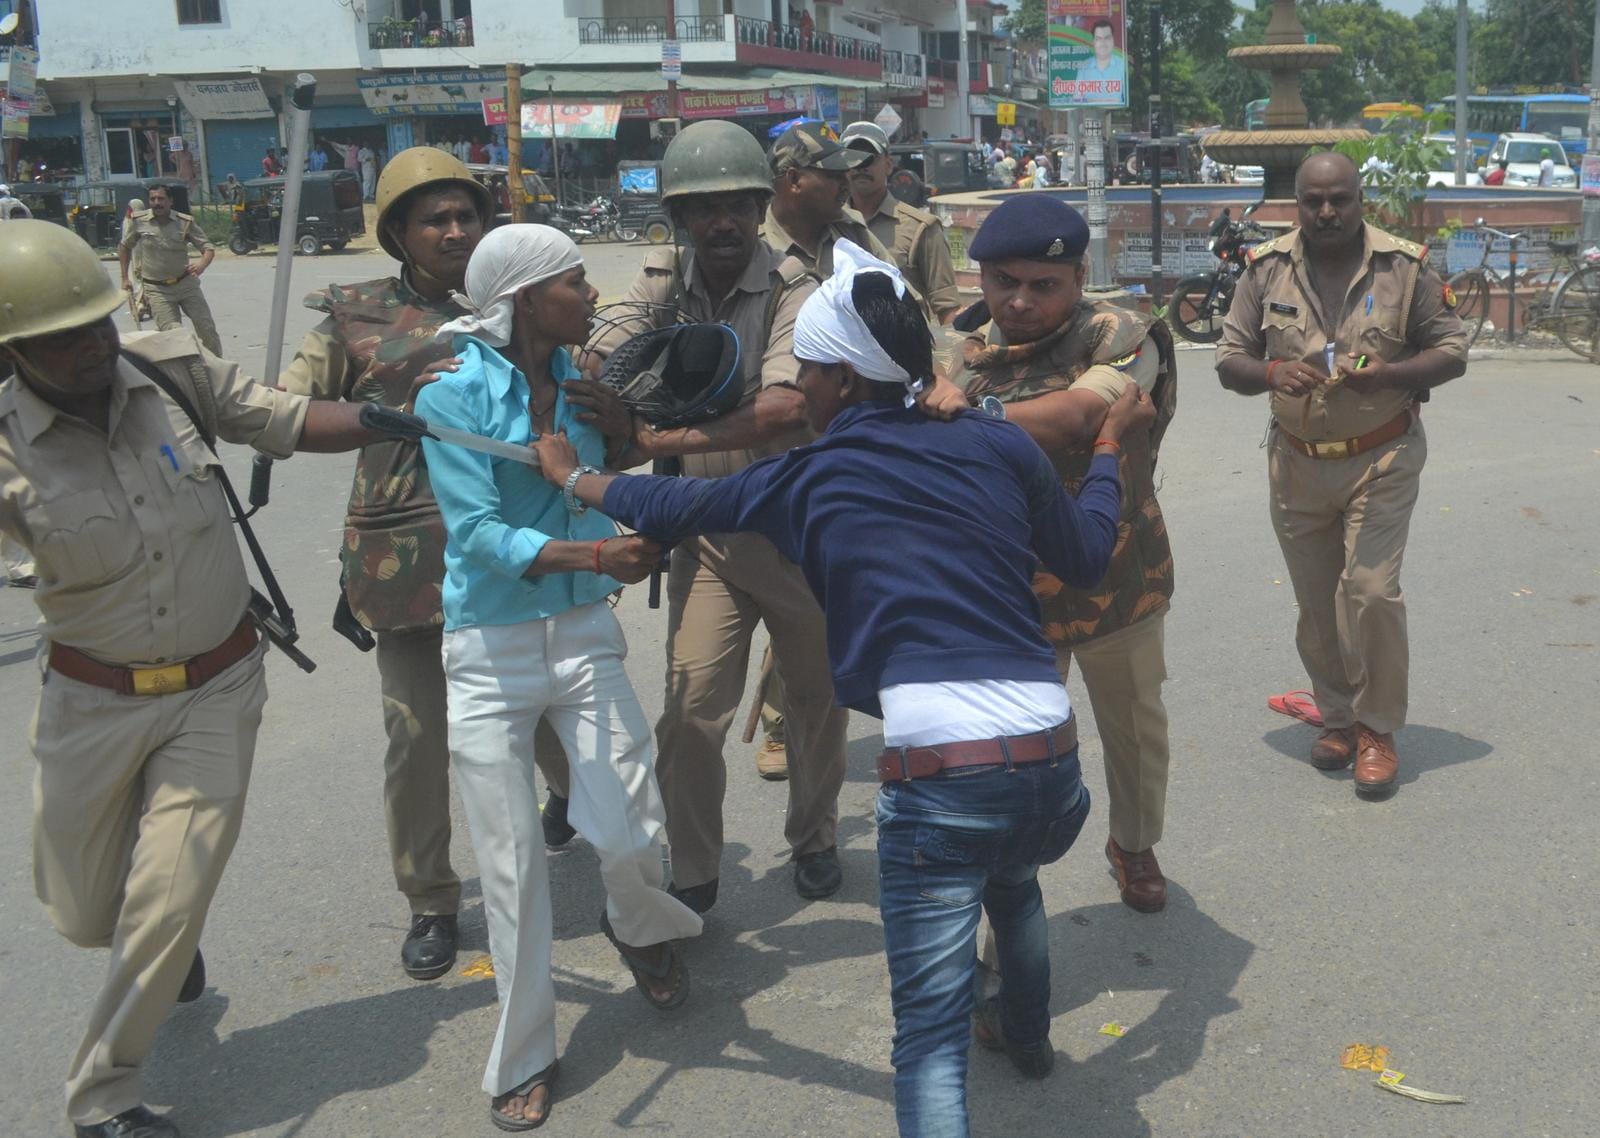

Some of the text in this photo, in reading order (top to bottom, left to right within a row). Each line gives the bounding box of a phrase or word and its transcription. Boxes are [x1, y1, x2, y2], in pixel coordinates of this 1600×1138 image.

[1053, 76, 1121, 96] दीपक कुमार राय
[708, 92, 738, 107] मिष्ठान
